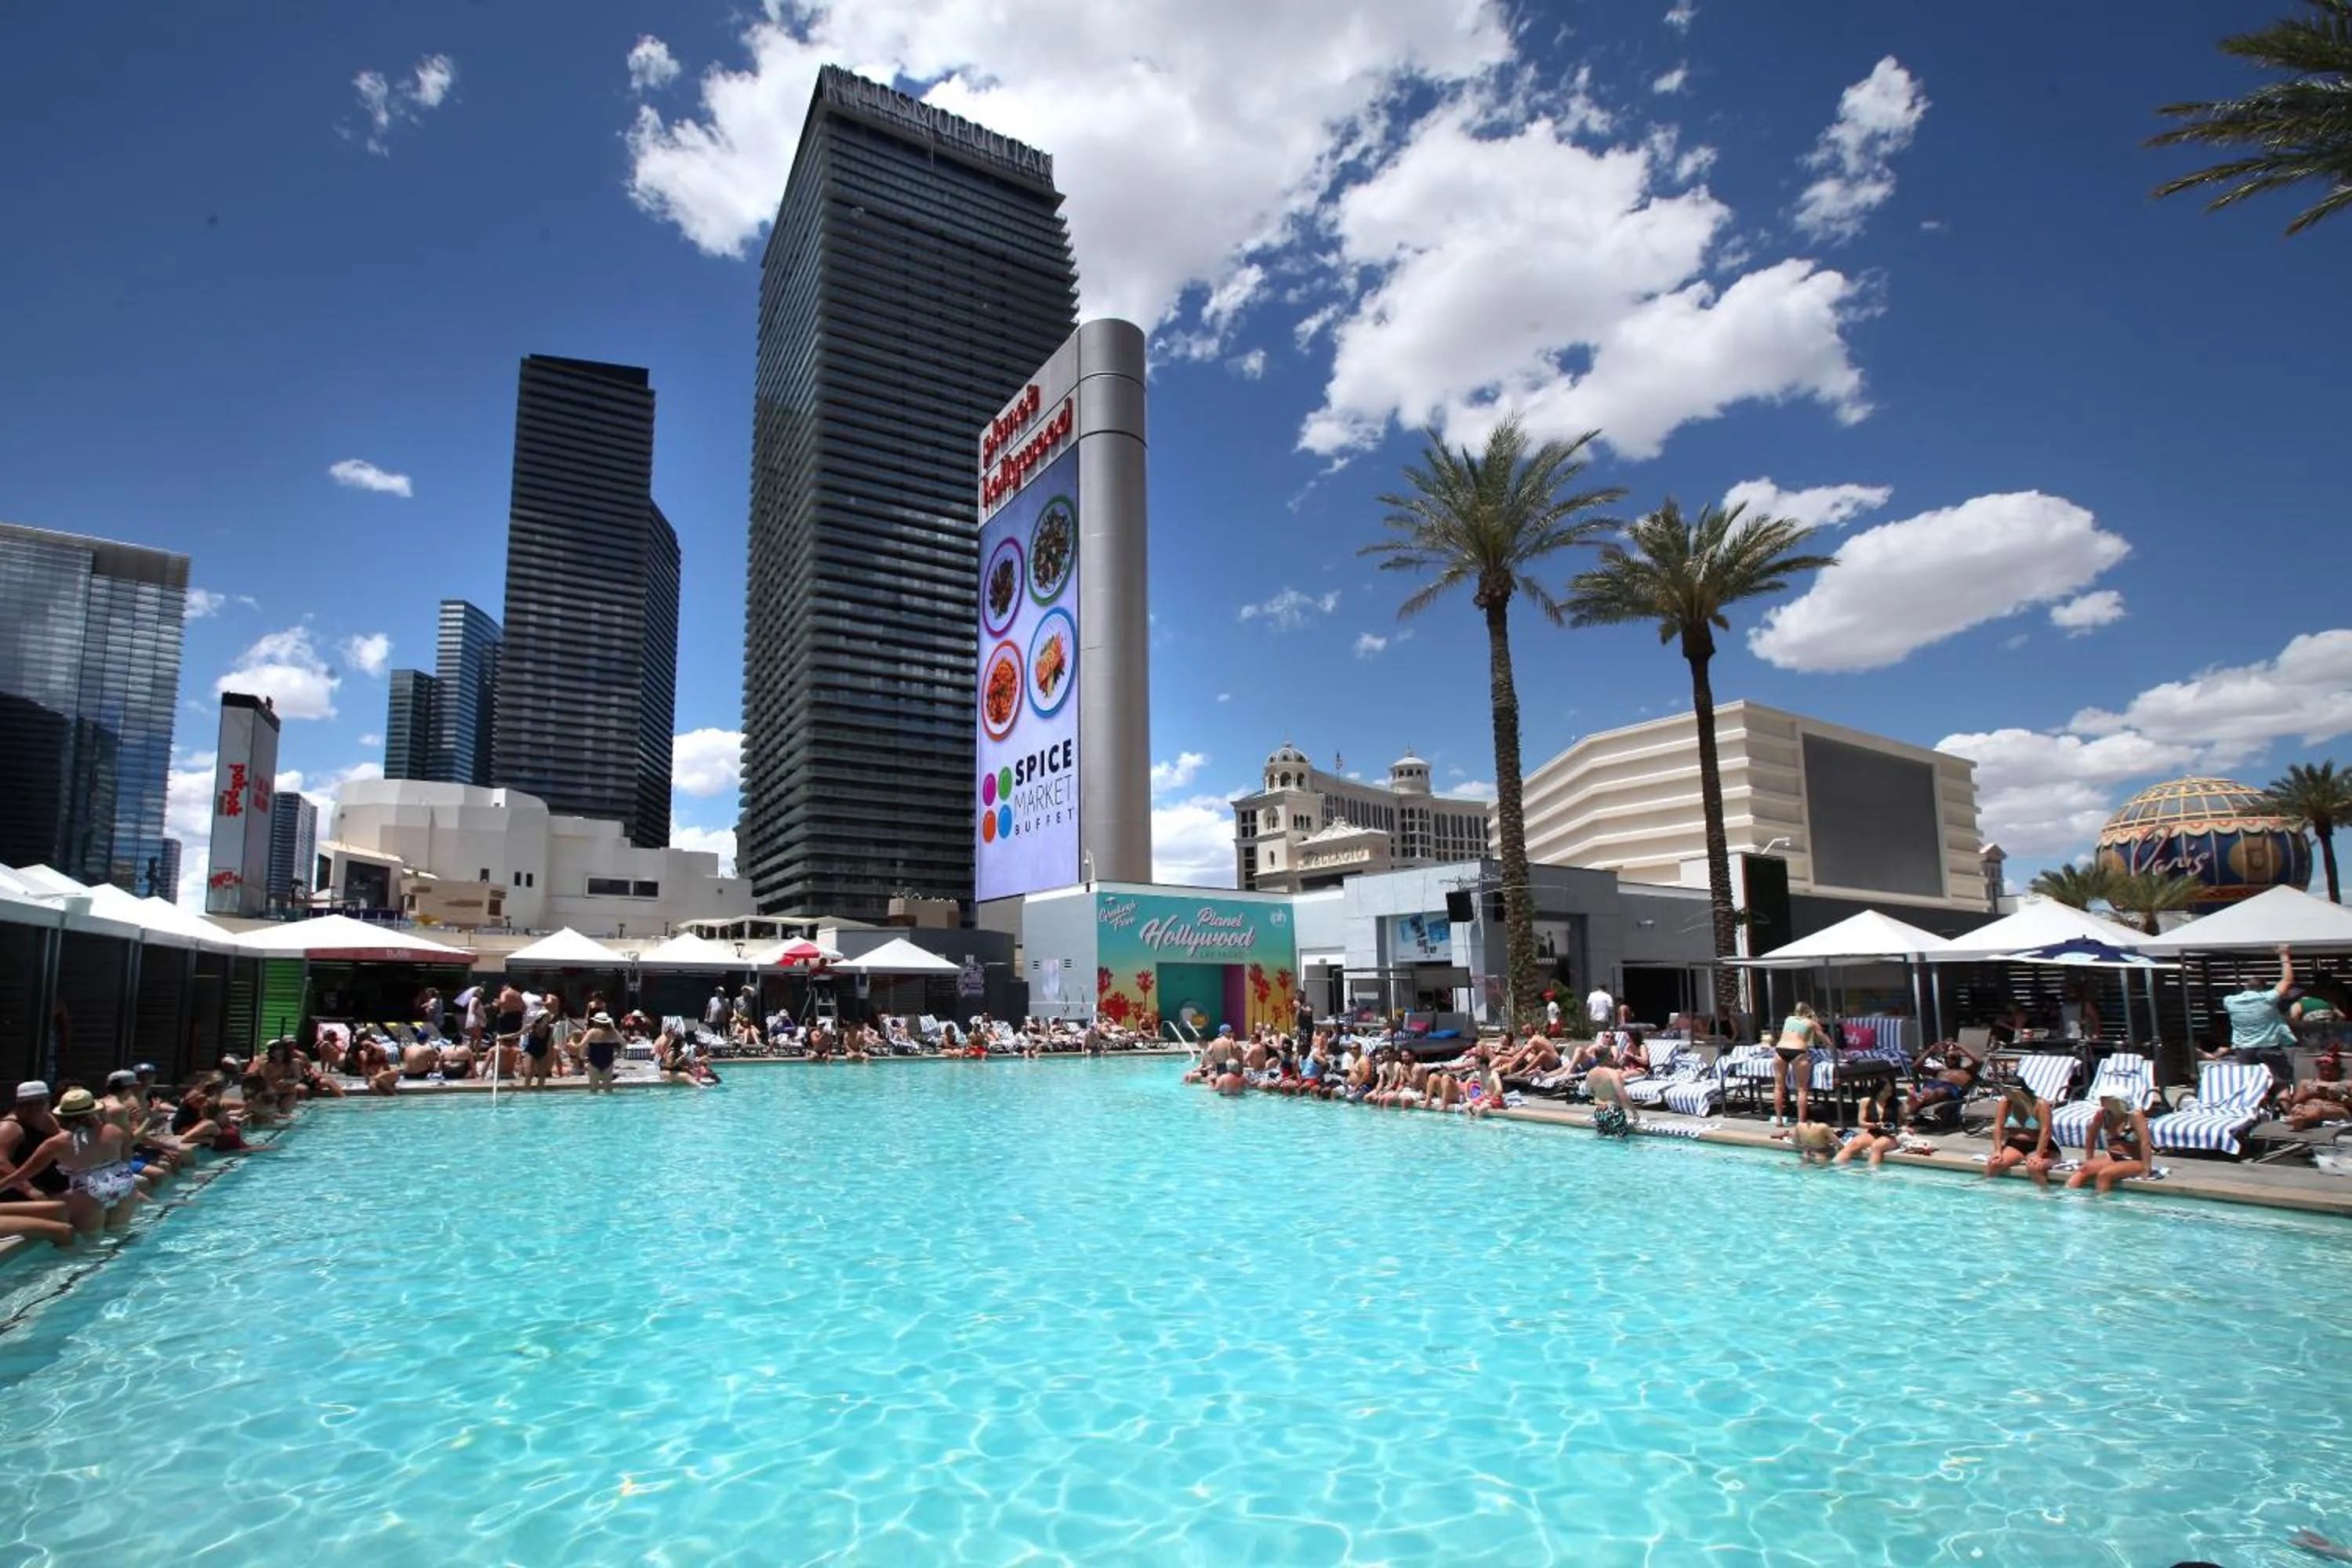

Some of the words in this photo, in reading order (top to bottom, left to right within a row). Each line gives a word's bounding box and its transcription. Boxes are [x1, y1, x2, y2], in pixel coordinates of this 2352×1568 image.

[982, 397, 1073, 508] hollywood
[1015, 739, 1072, 786] SPICE
[1014, 775, 1073, 815] MARKET
[1015, 808, 1073, 837] BUFFET
[1139, 915, 1254, 956] Hollywood
[1197, 906, 1245, 928] Planet
